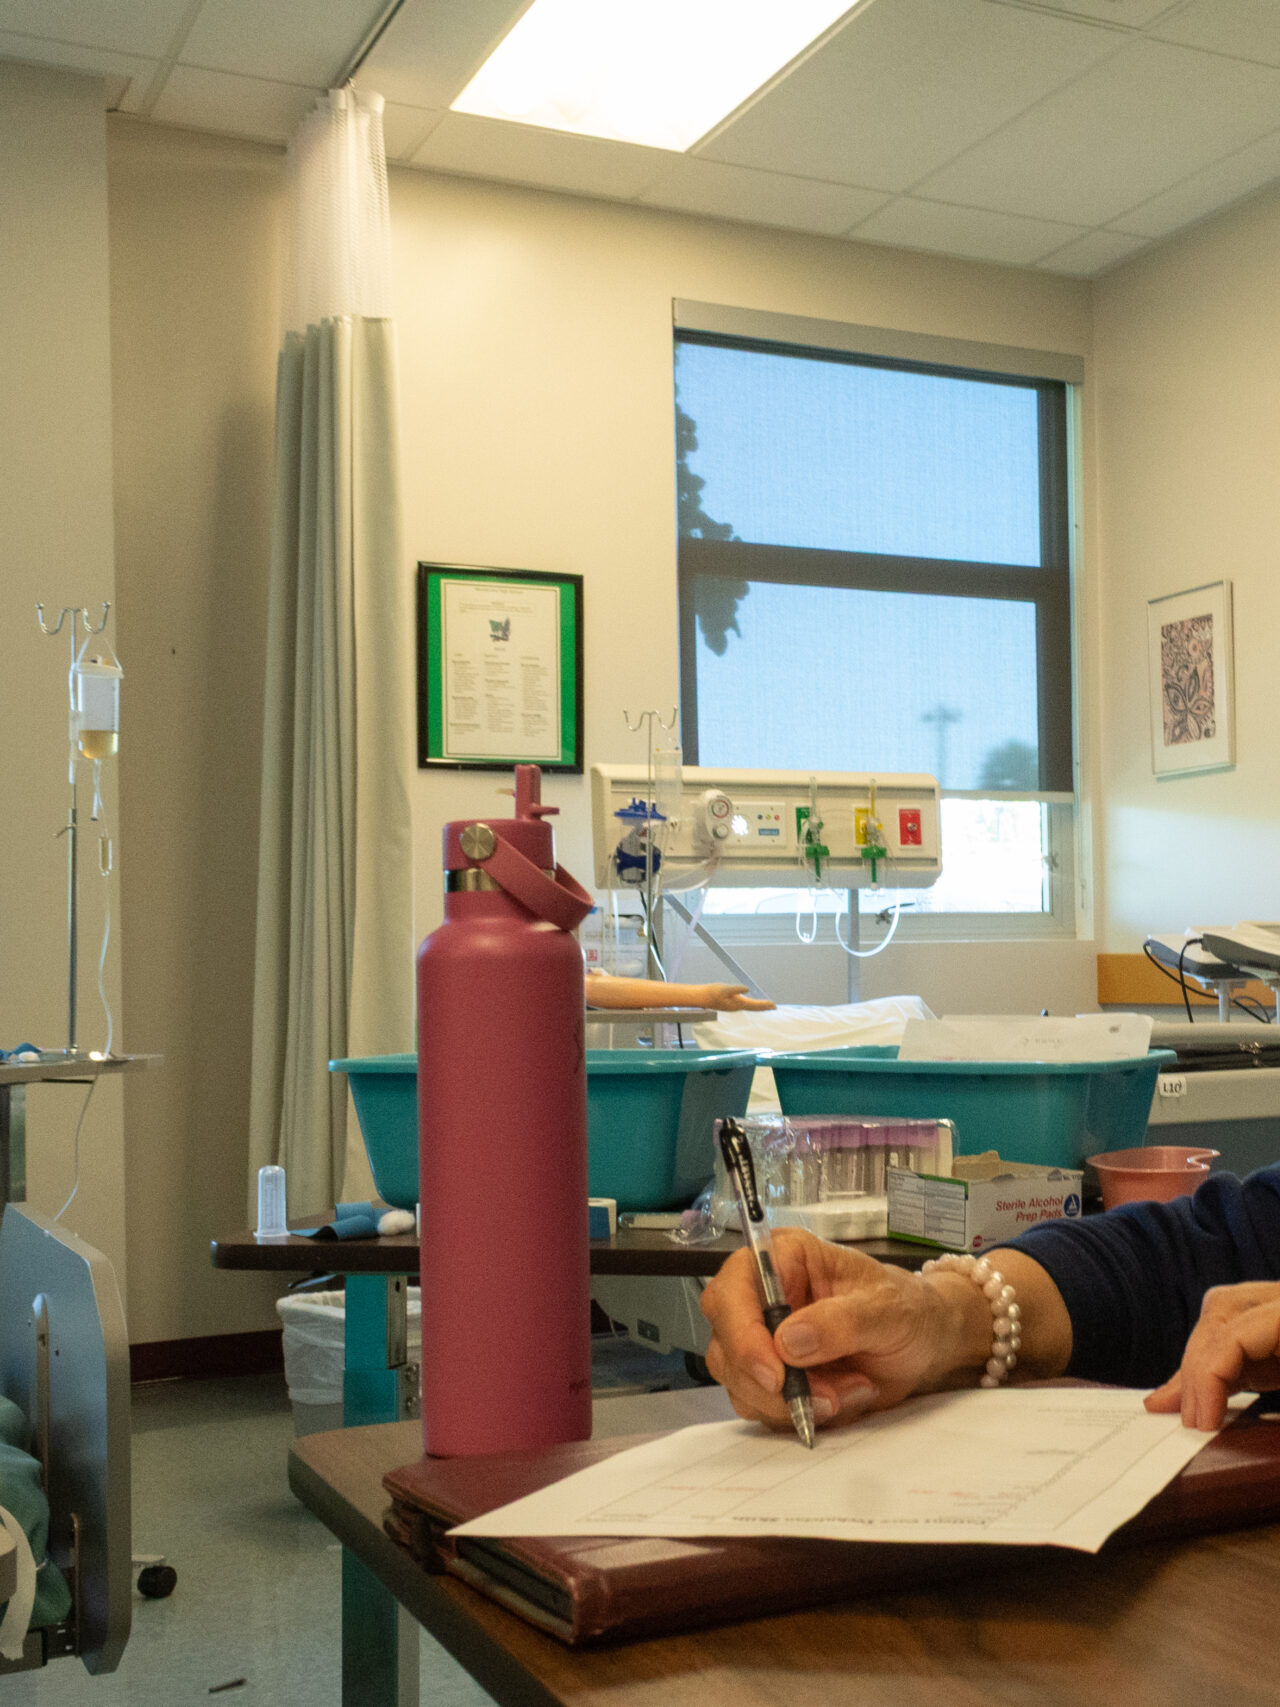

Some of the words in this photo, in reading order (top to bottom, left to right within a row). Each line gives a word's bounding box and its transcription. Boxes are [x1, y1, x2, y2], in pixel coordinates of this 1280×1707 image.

[995, 1200, 1026, 1212] Sterile
[1028, 1196, 1064, 1209] Alcohol
[1015, 1211, 1038, 1223] Prep
[1040, 1208, 1063, 1220] Pads
